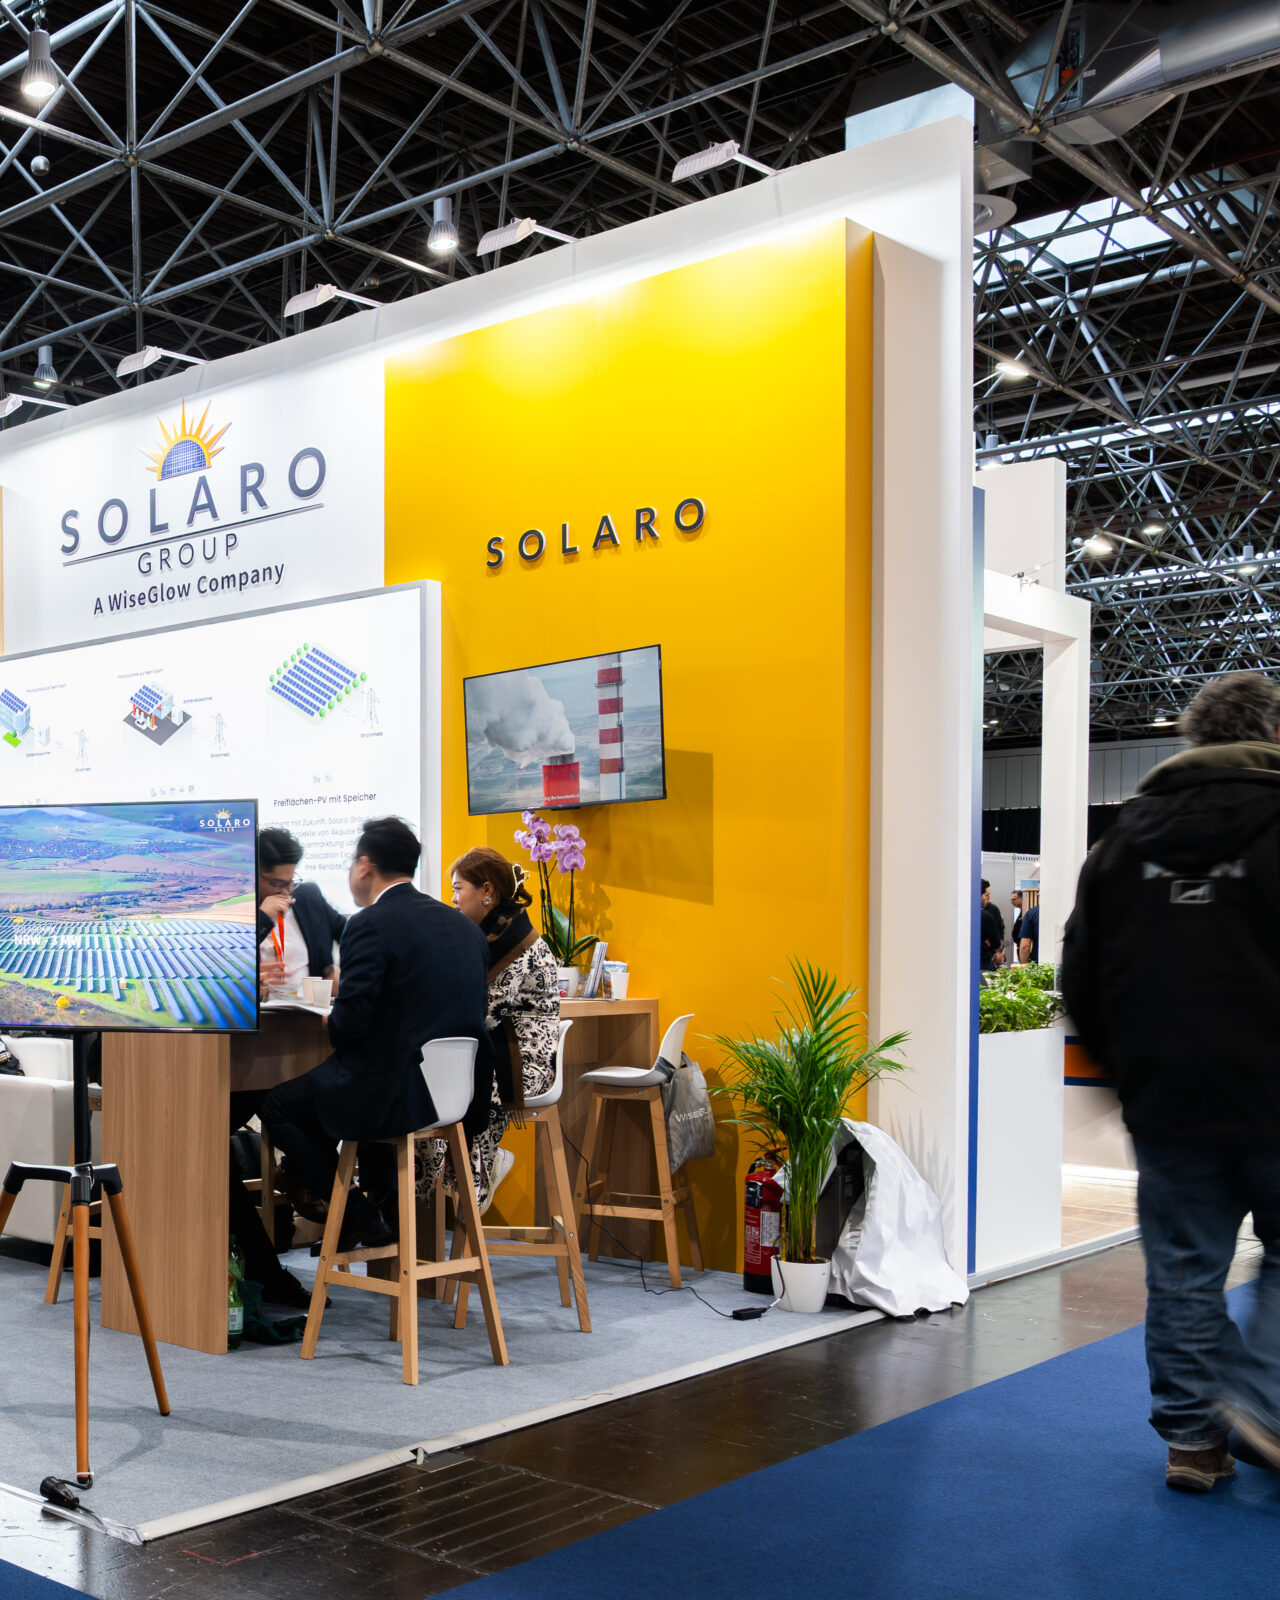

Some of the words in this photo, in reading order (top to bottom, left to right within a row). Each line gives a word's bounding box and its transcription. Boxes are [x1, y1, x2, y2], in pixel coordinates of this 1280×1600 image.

[60, 446, 327, 556] SOLARO
[486, 497, 707, 569] SOLARO
[138, 533, 239, 575] GROUP
[93, 597, 104, 616] A
[107, 582, 192, 614] WiseGlow
[197, 562, 285, 597] Company
[328, 794, 341, 803] mit
[343, 792, 377, 804] Speicher
[200, 818, 251, 827] SOLARO
[328, 816, 348, 825] Solaro
[14, 934, 41, 945] NRW
[51, 936, 58, 946] 3
